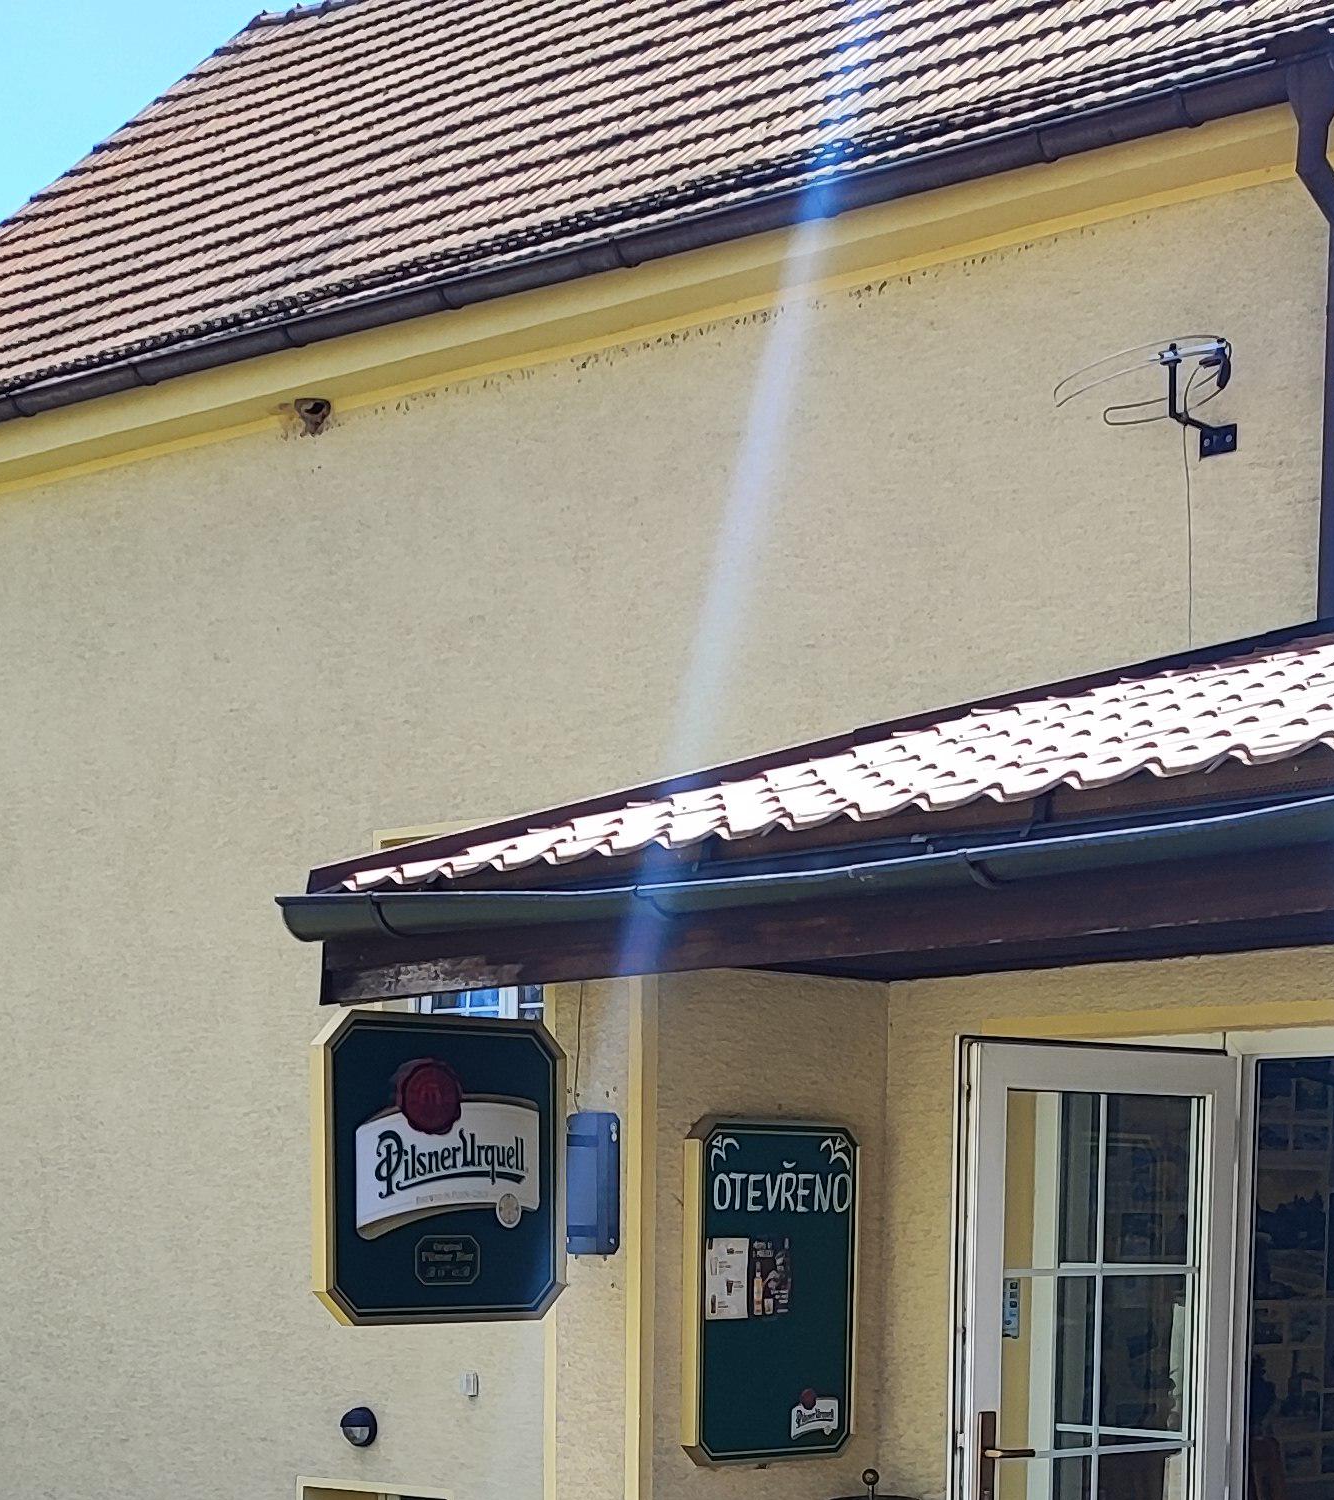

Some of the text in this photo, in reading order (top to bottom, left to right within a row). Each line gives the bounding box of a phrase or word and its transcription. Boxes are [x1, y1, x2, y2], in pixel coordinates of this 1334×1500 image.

[374, 1127, 526, 1199] Pilsner Urquell
[713, 1160, 853, 1213] OTEVŘENO
